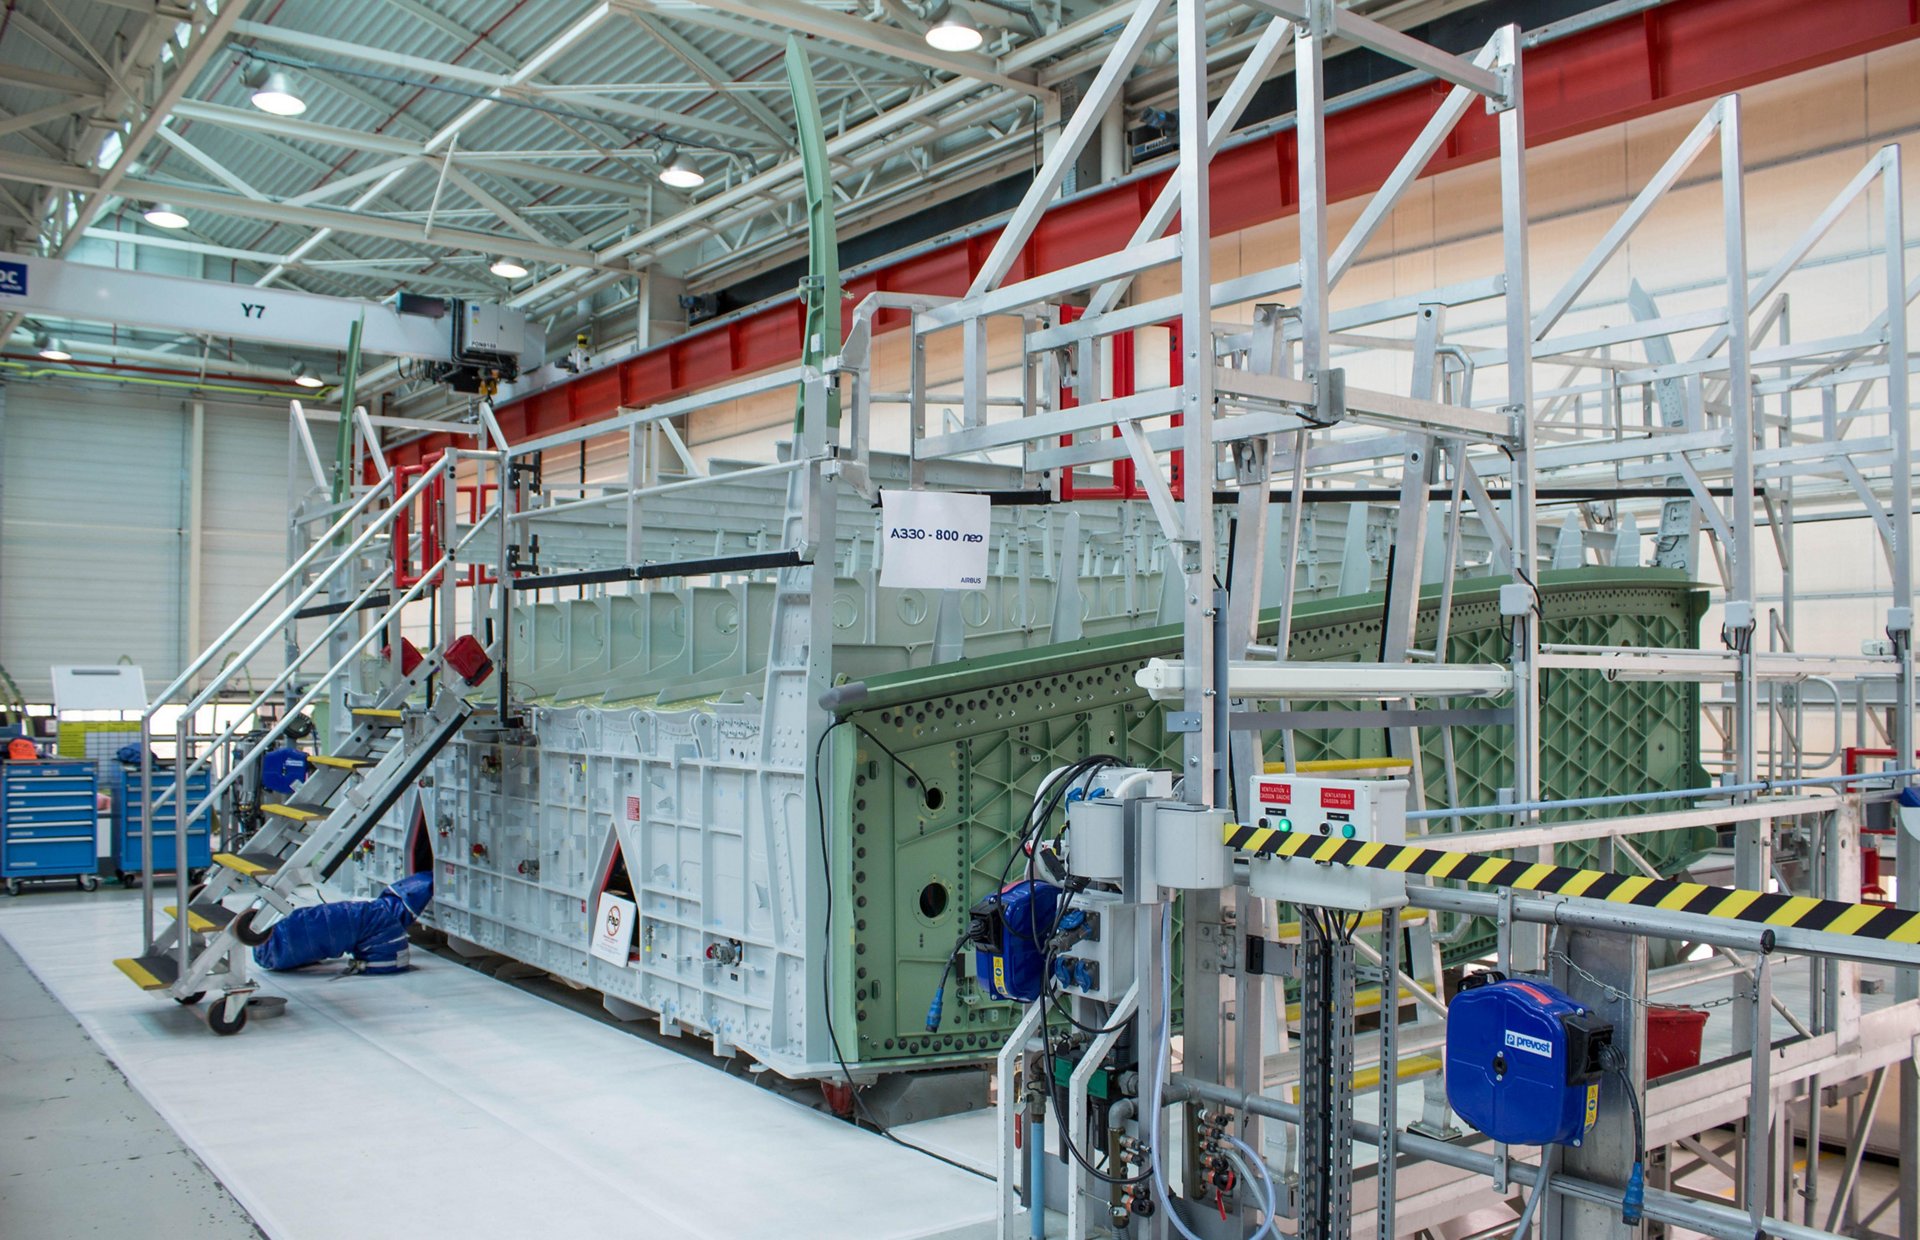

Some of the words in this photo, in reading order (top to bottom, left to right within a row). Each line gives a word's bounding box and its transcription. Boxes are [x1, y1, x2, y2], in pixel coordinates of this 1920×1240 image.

[241, 302, 266, 319] Y7
[890, 528, 926, 540] A330
[935, 529, 959, 542] 800
[962, 533, 984, 543] neo
[1261, 786, 1285, 794] VENTILATION
[1517, 1036, 1550, 1053] prevost
